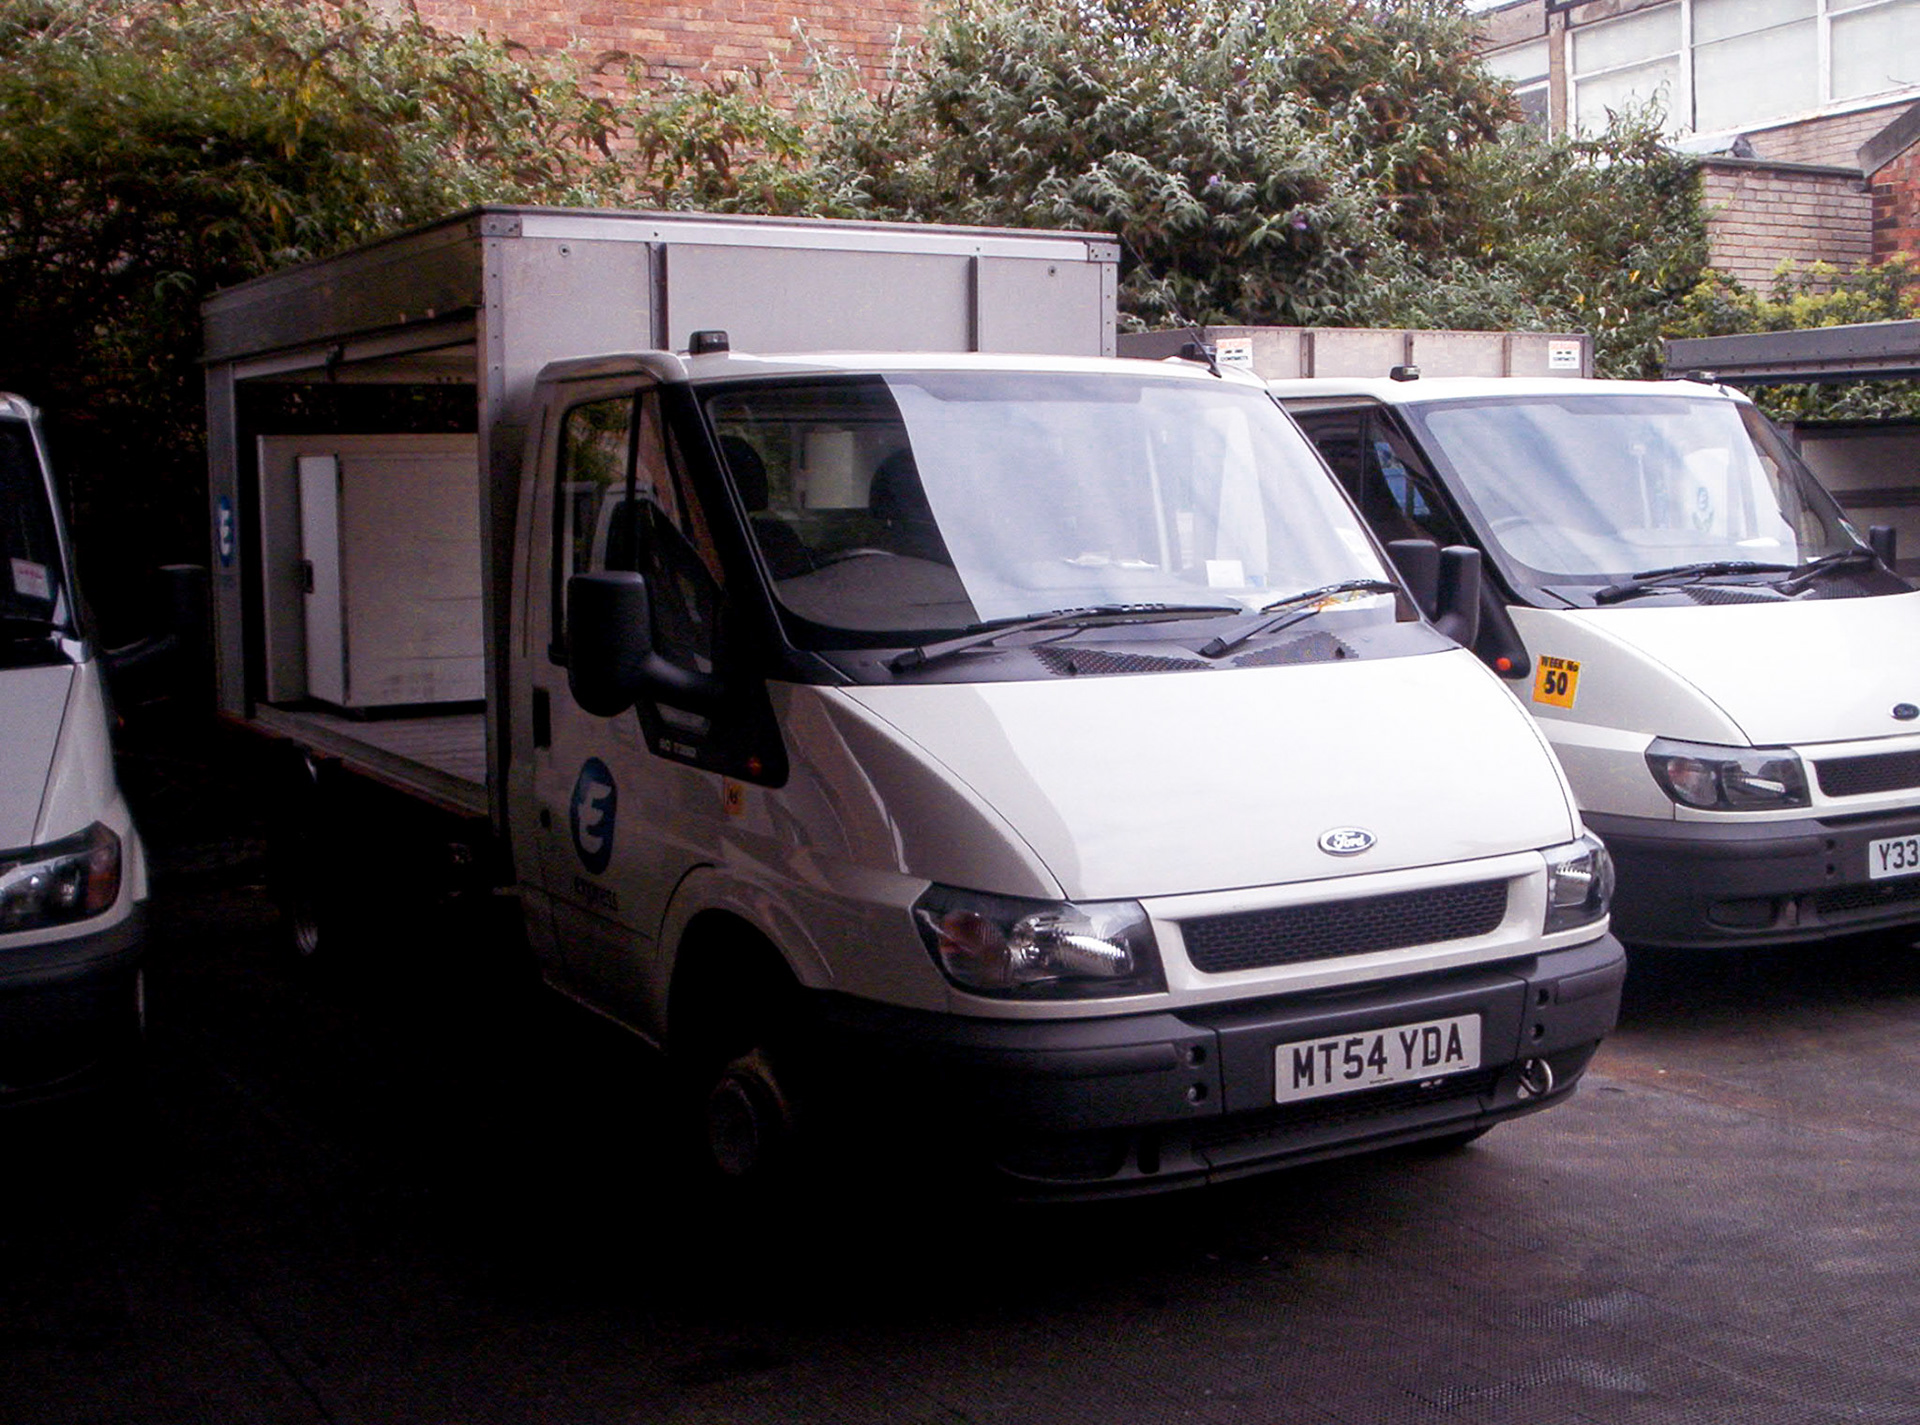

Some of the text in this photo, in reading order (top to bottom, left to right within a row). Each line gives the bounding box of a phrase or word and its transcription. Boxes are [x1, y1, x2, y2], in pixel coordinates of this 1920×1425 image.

[1544, 670, 1568, 695] 50
[1333, 831, 1365, 850] Ford
[1293, 1022, 1464, 1089] MT54 YDA
